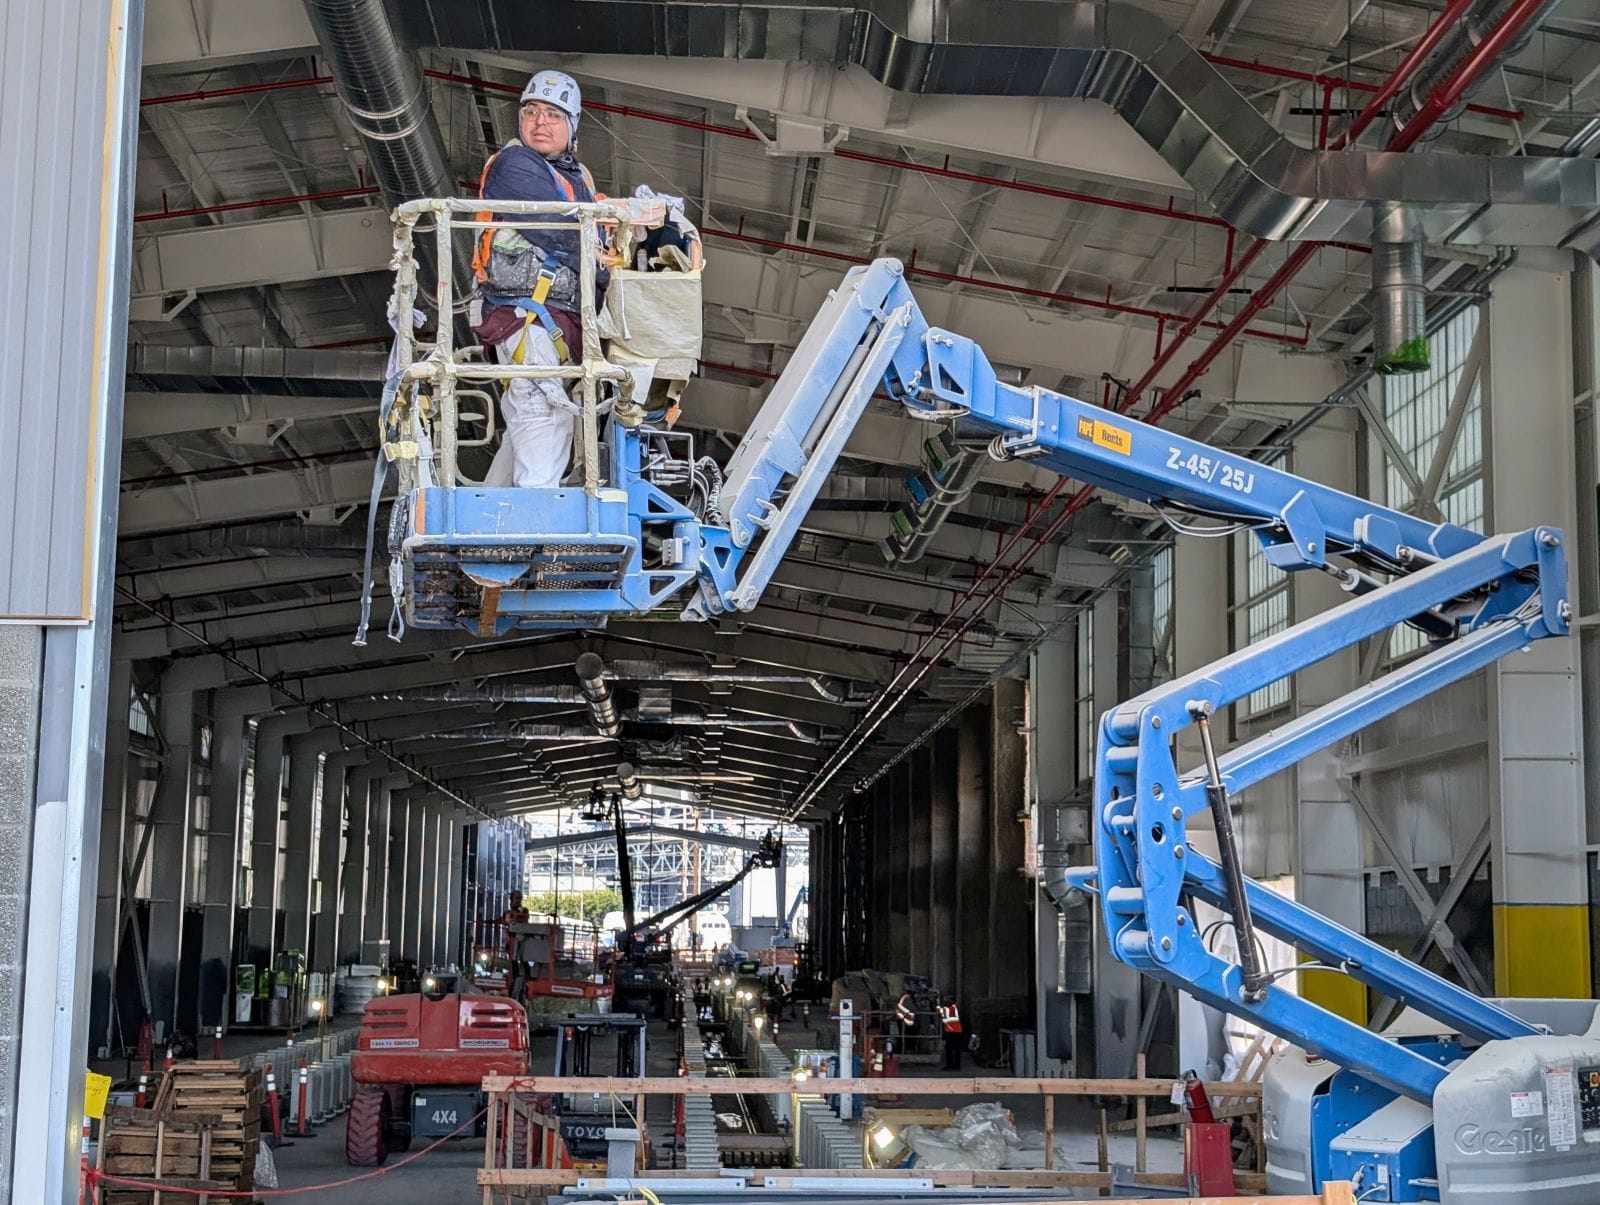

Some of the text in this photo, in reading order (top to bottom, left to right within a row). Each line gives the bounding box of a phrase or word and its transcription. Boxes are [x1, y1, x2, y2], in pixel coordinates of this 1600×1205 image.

[1101, 429, 1124, 447] Rents
[431, 1109, 458, 1124] 4X4
[566, 1126, 606, 1138] TOYO
[1454, 1123, 1546, 1155] Genie
